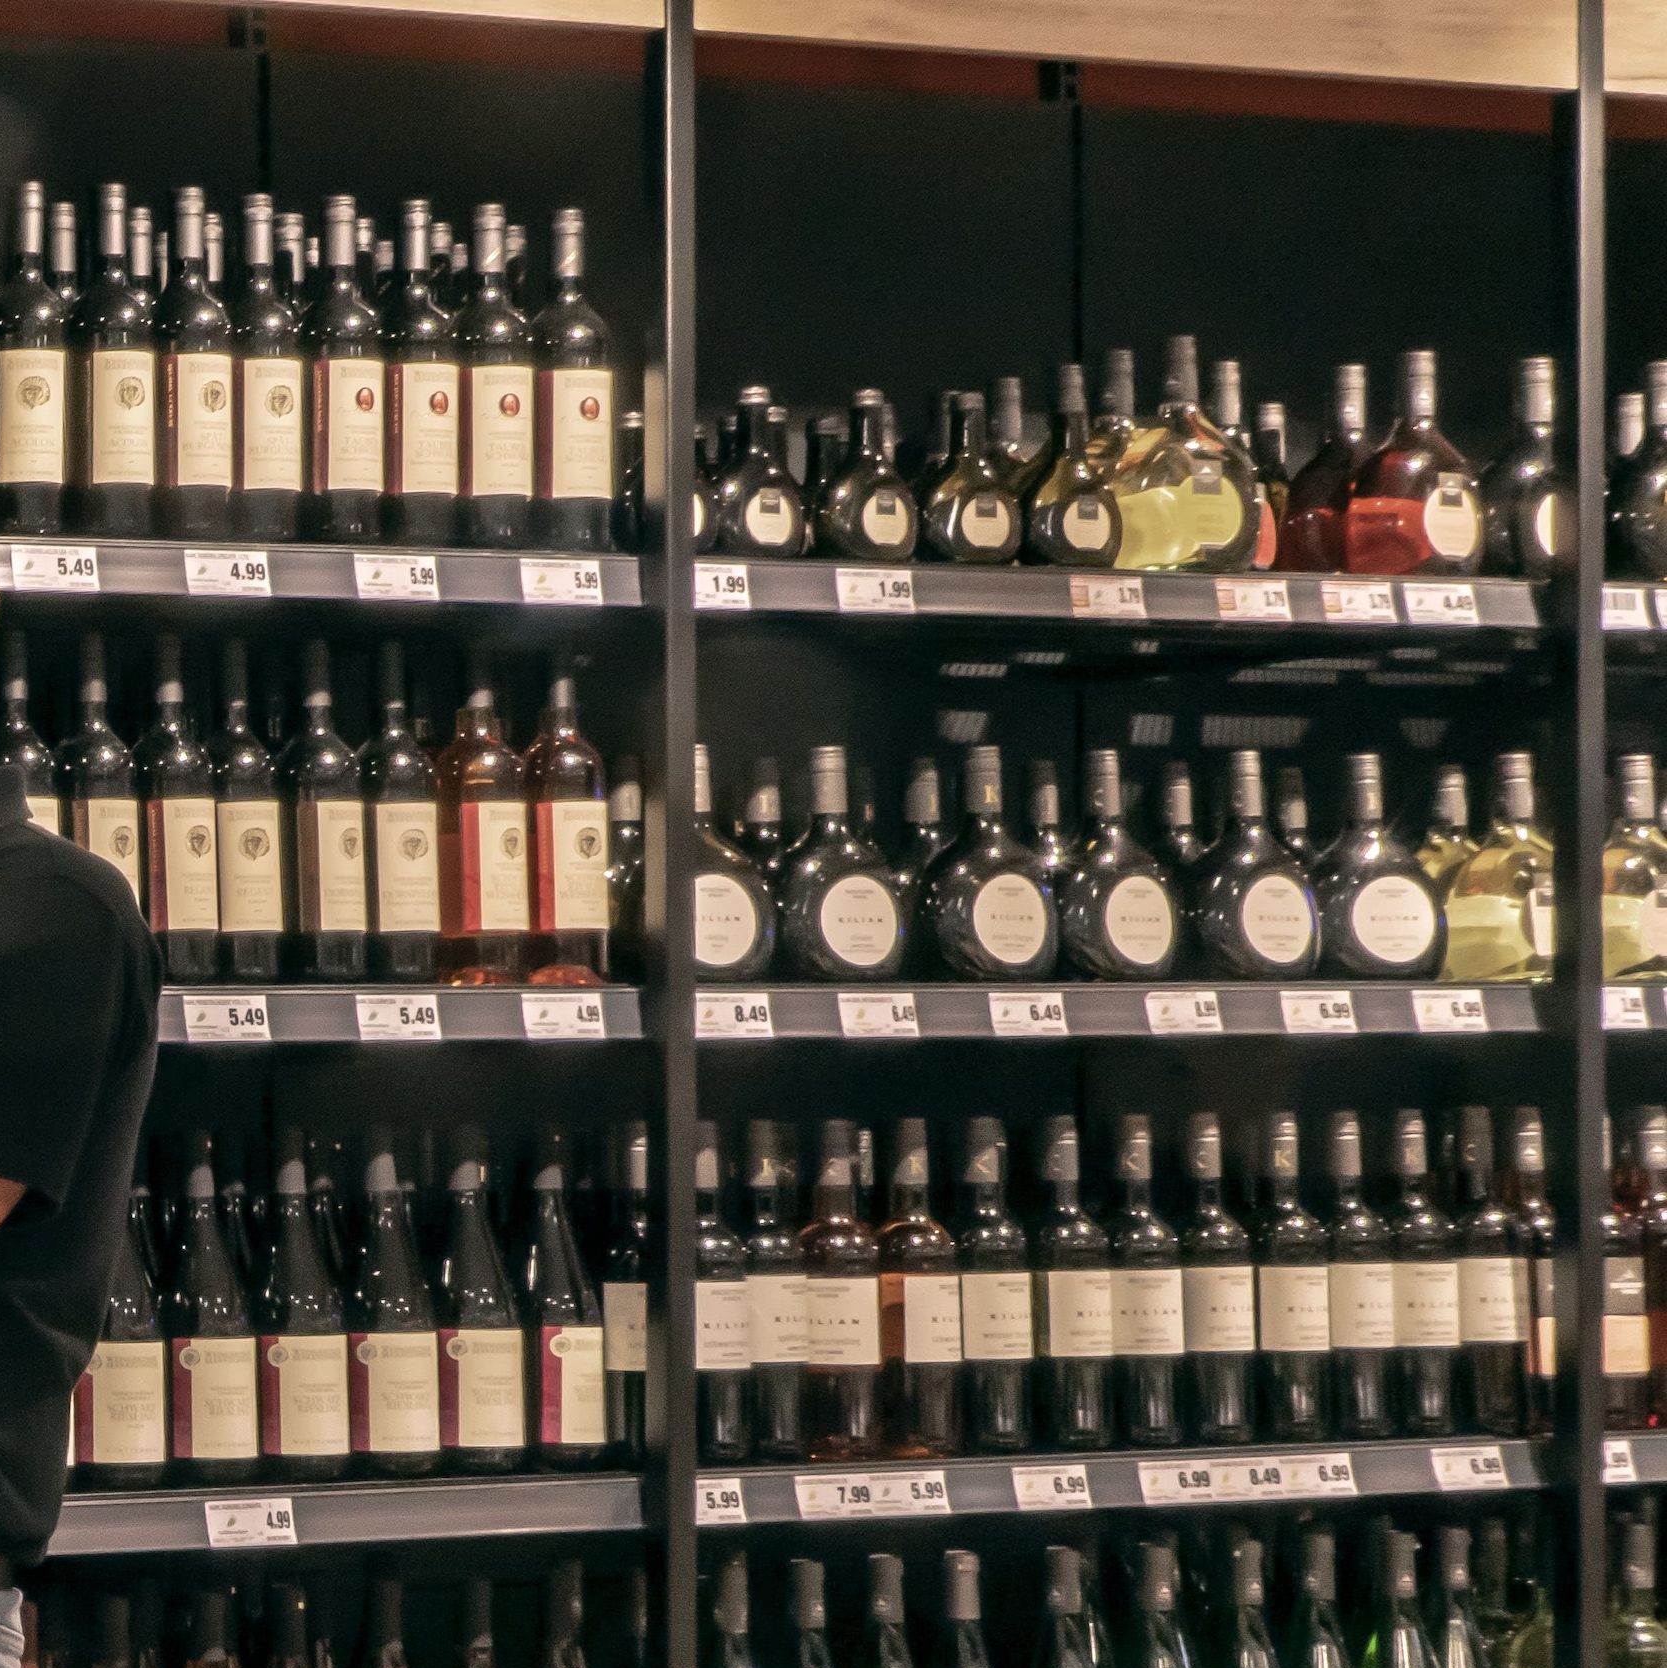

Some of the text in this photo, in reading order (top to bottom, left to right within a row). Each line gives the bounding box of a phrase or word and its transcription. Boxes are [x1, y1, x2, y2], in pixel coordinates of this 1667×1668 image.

[57, 557, 94, 577] 5.49
[230, 561, 266, 581] 4.99
[410, 567, 434, 586] 5.99
[574, 571, 598, 589] 5.99
[712, 575, 745, 594] 1.99
[878, 581, 910, 599] 1.99
[228, 1007, 265, 1026] 5.49
[399, 1007, 435, 1025] 5.49
[734, 1004, 768, 1022] 8.49
[892, 1005, 915, 1022] 6.49
[1029, 1004, 1061, 1021] 6.49
[1319, 1002, 1350, 1019] 6.99
[1450, 1001, 1482, 1018] 6.99
[1178, 1470, 1210, 1488] 6.99
[1318, 1465, 1350, 1482] 6.99
[910, 1482, 944, 1499] 5.99
[1054, 1476, 1085, 1493] 6.99
[706, 1491, 740, 1509] 5.99
[836, 1486, 870, 1504] 7.99
[266, 1510, 291, 1529] 4.99
